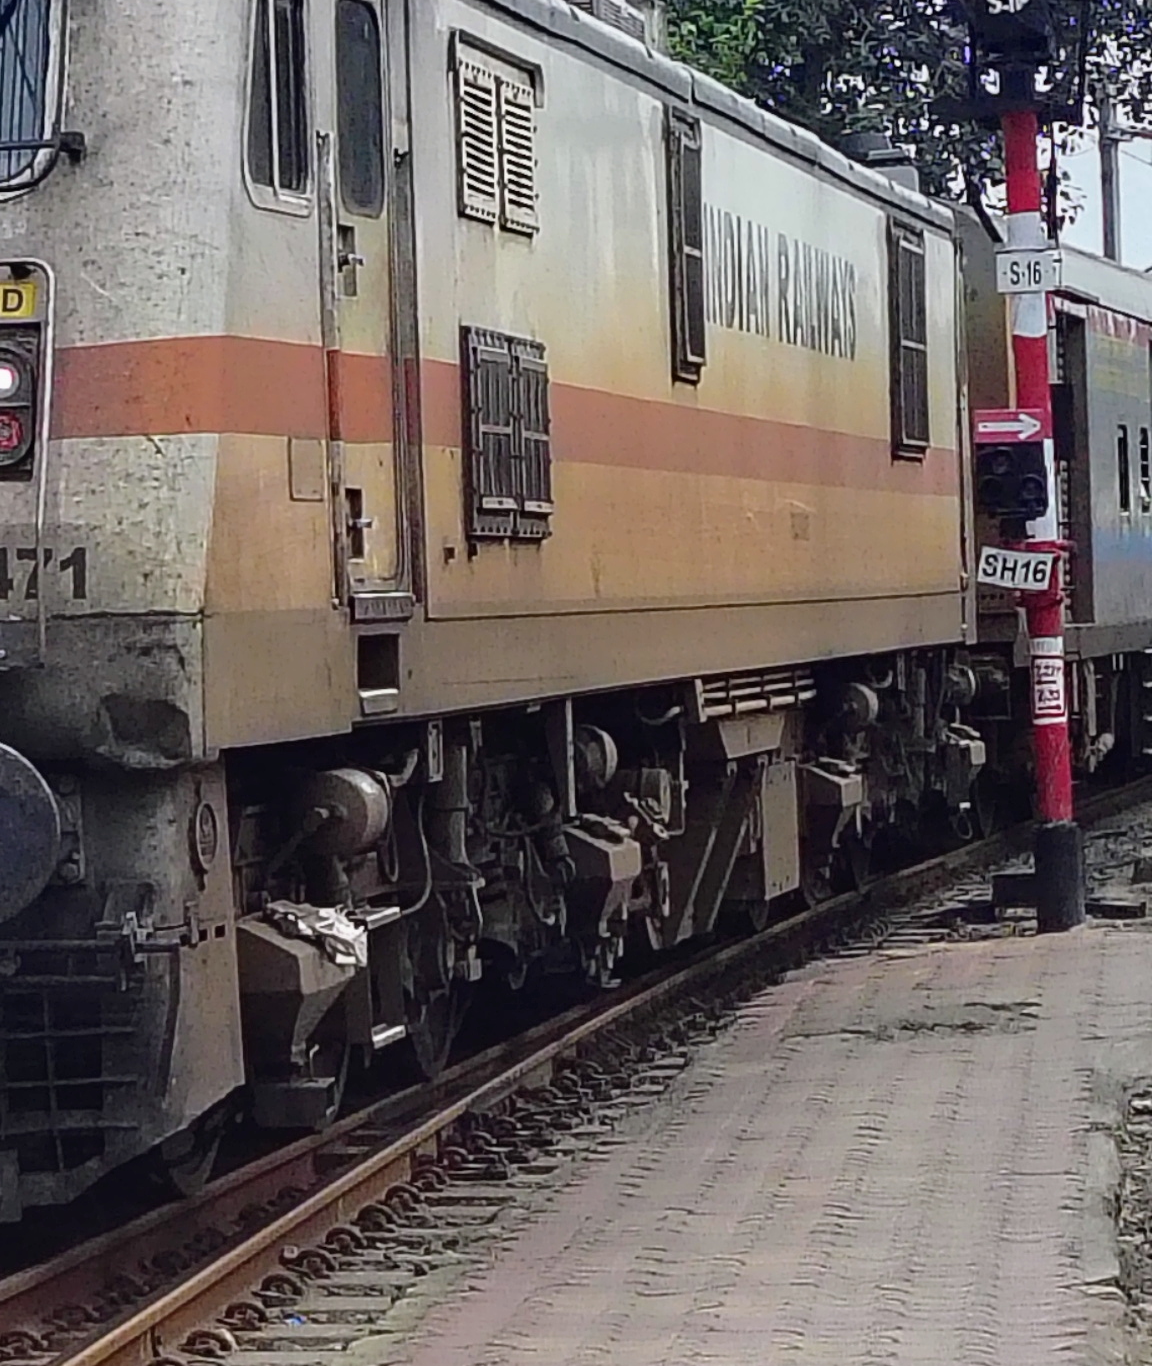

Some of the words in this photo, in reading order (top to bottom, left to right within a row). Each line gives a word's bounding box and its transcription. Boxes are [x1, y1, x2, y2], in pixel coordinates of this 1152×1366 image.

[703, 201, 770, 339] INDIAN
[778, 232, 857, 362] RAILWAYS
[981, 553, 1049, 584] SH16
